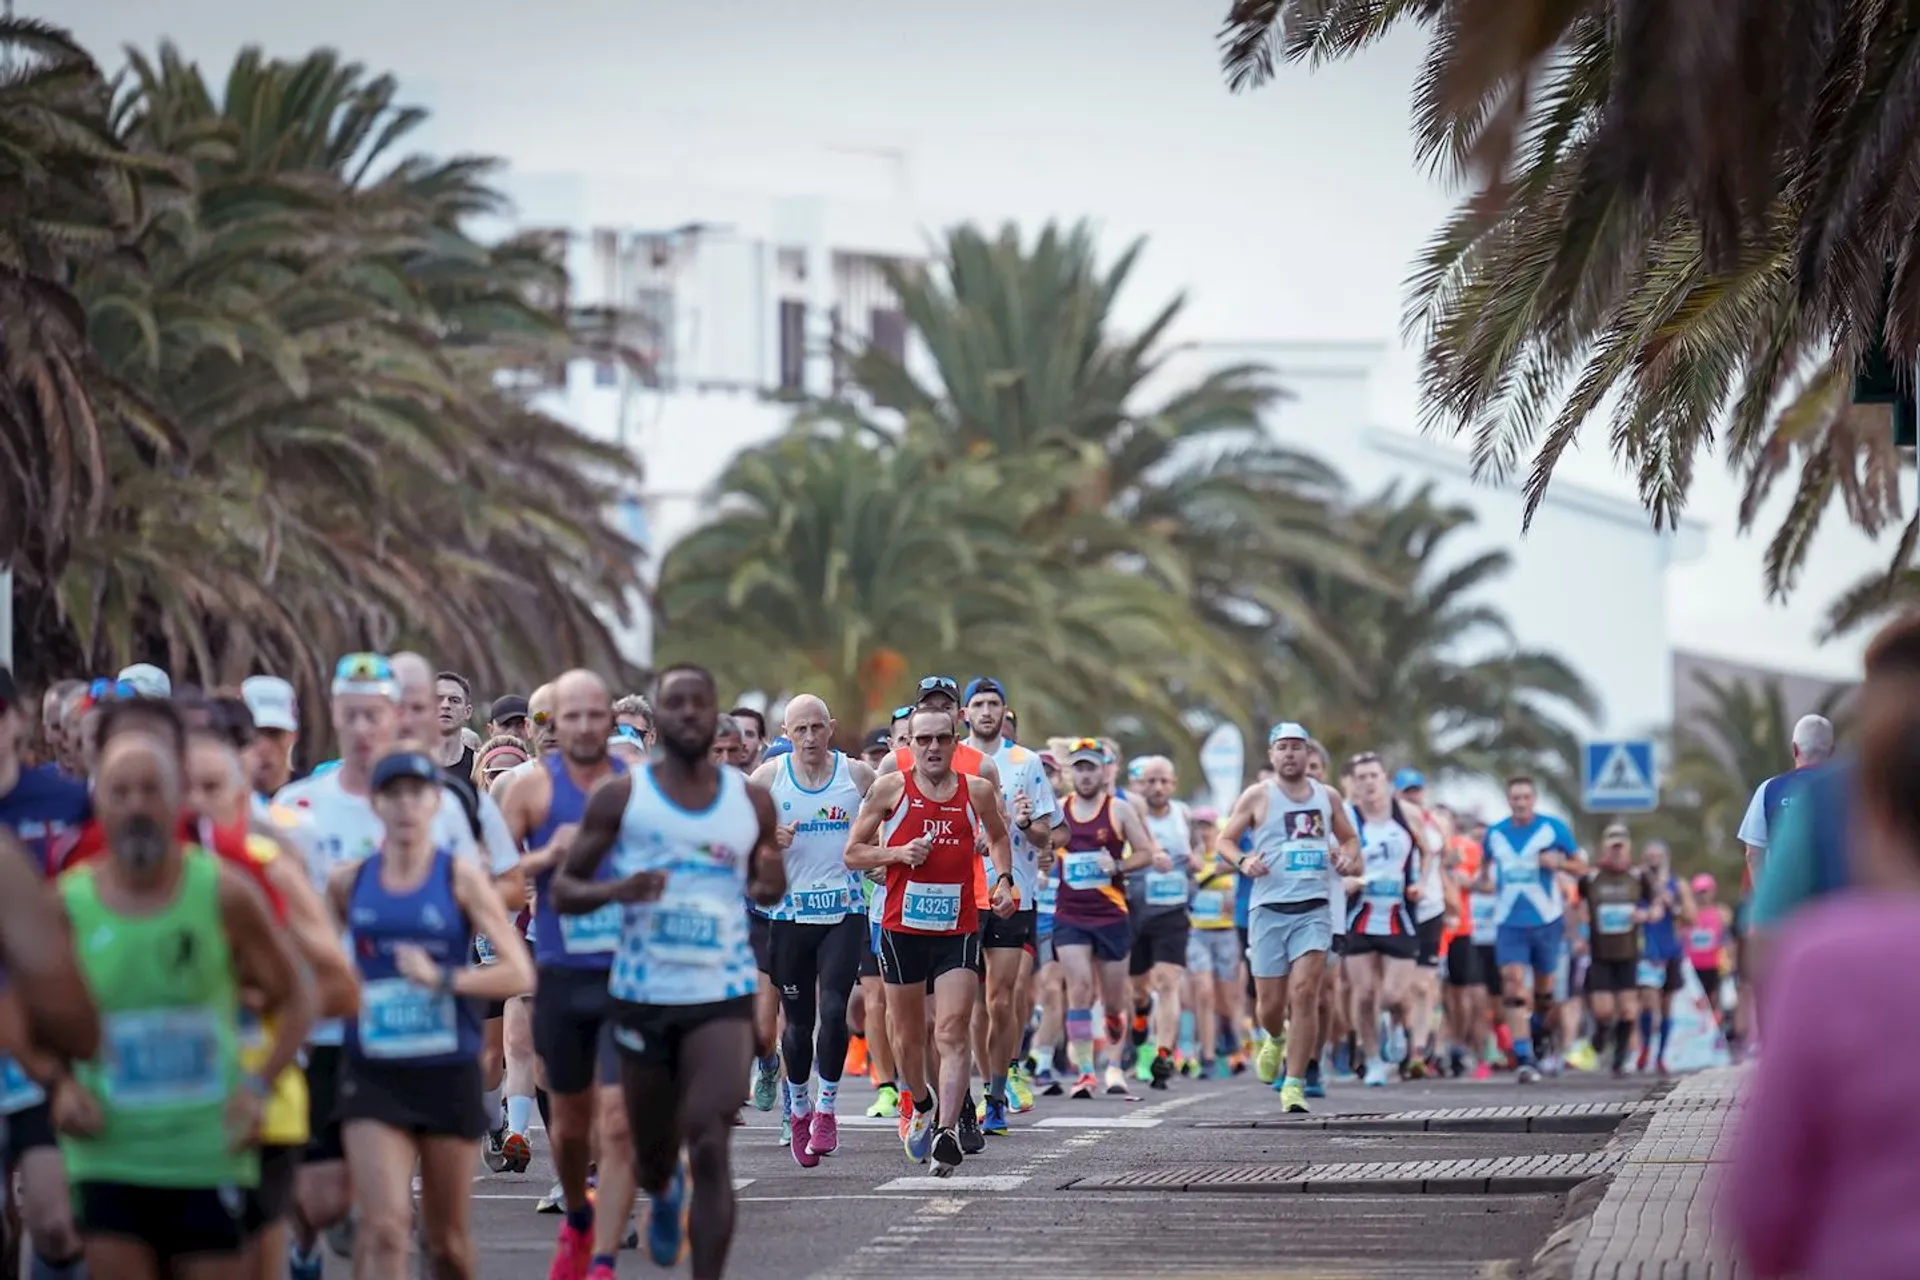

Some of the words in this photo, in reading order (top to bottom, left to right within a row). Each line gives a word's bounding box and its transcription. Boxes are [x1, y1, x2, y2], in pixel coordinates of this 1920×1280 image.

[793, 820, 849, 832] RATHON
[923, 819, 953, 837] DJK
[808, 891, 836, 909] 4107
[916, 897, 950, 915] 4325
